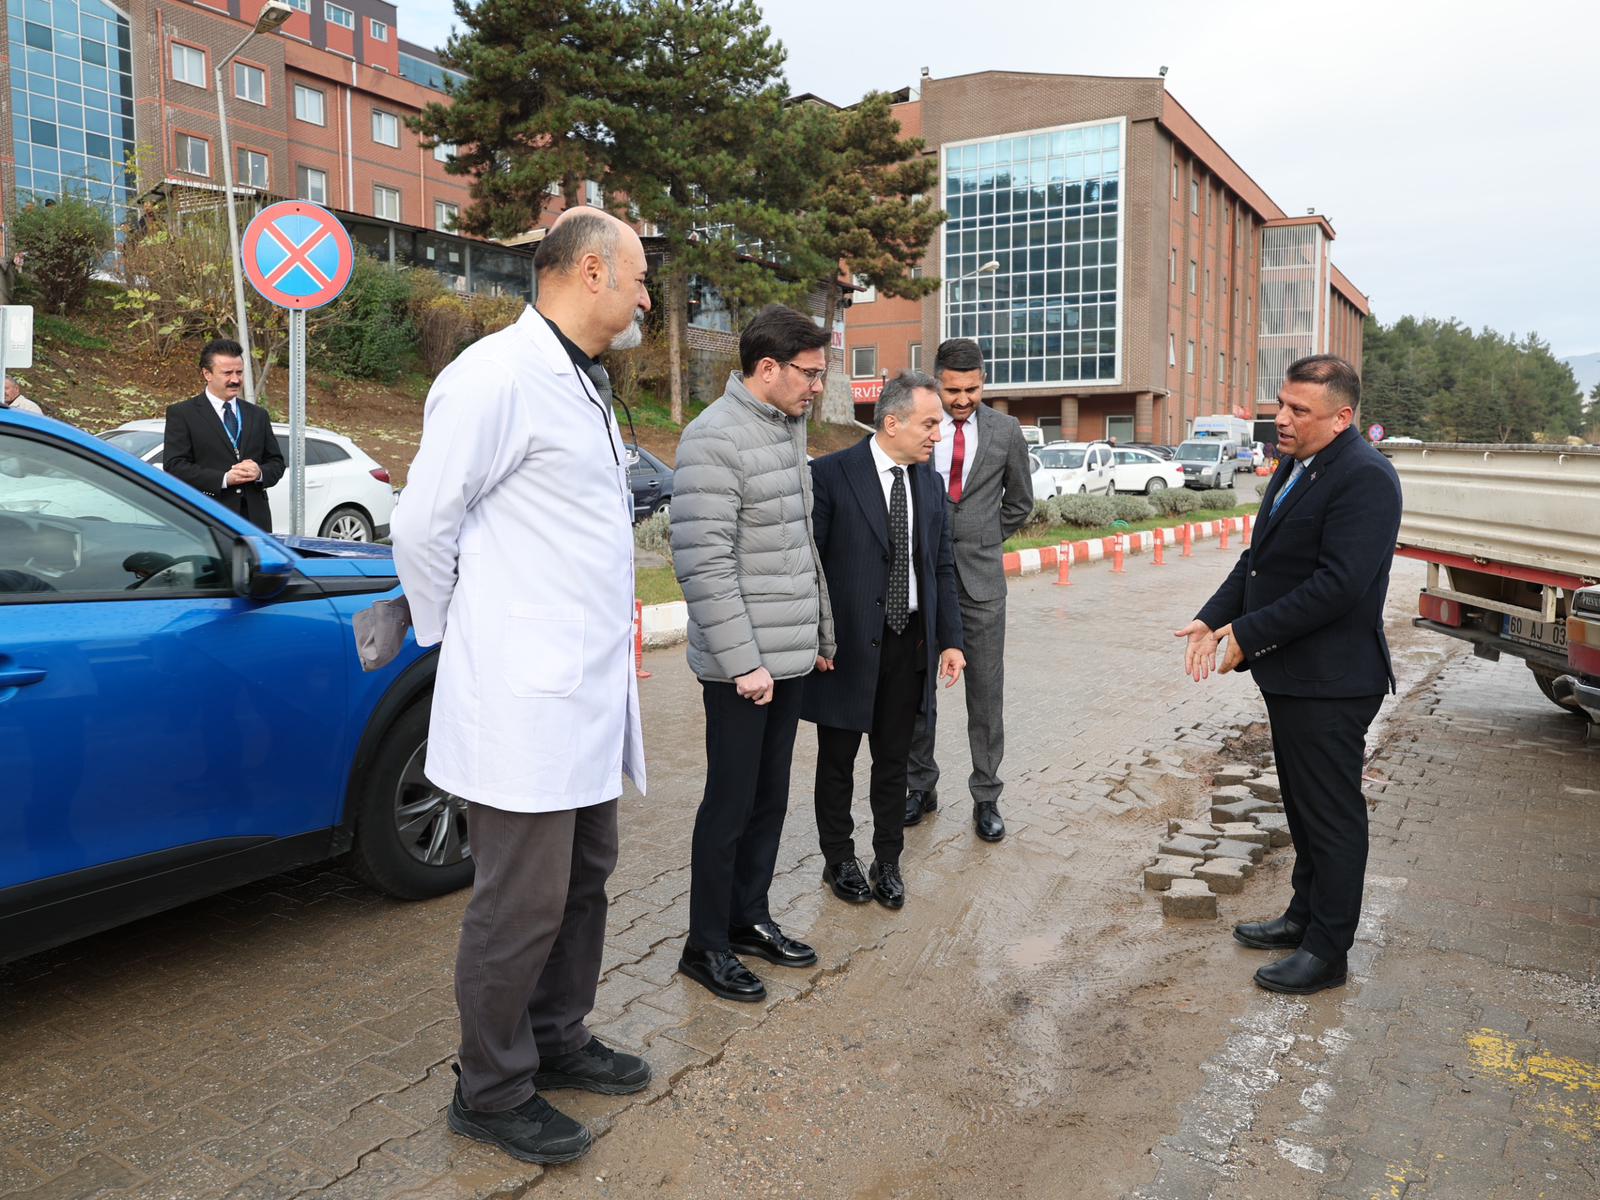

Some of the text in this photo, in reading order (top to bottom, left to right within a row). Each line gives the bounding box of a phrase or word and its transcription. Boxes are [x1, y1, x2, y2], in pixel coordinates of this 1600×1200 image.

[1510, 617, 1522, 634] 60
[1530, 622, 1543, 640] AJ
[1552, 626, 1568, 646] 03
